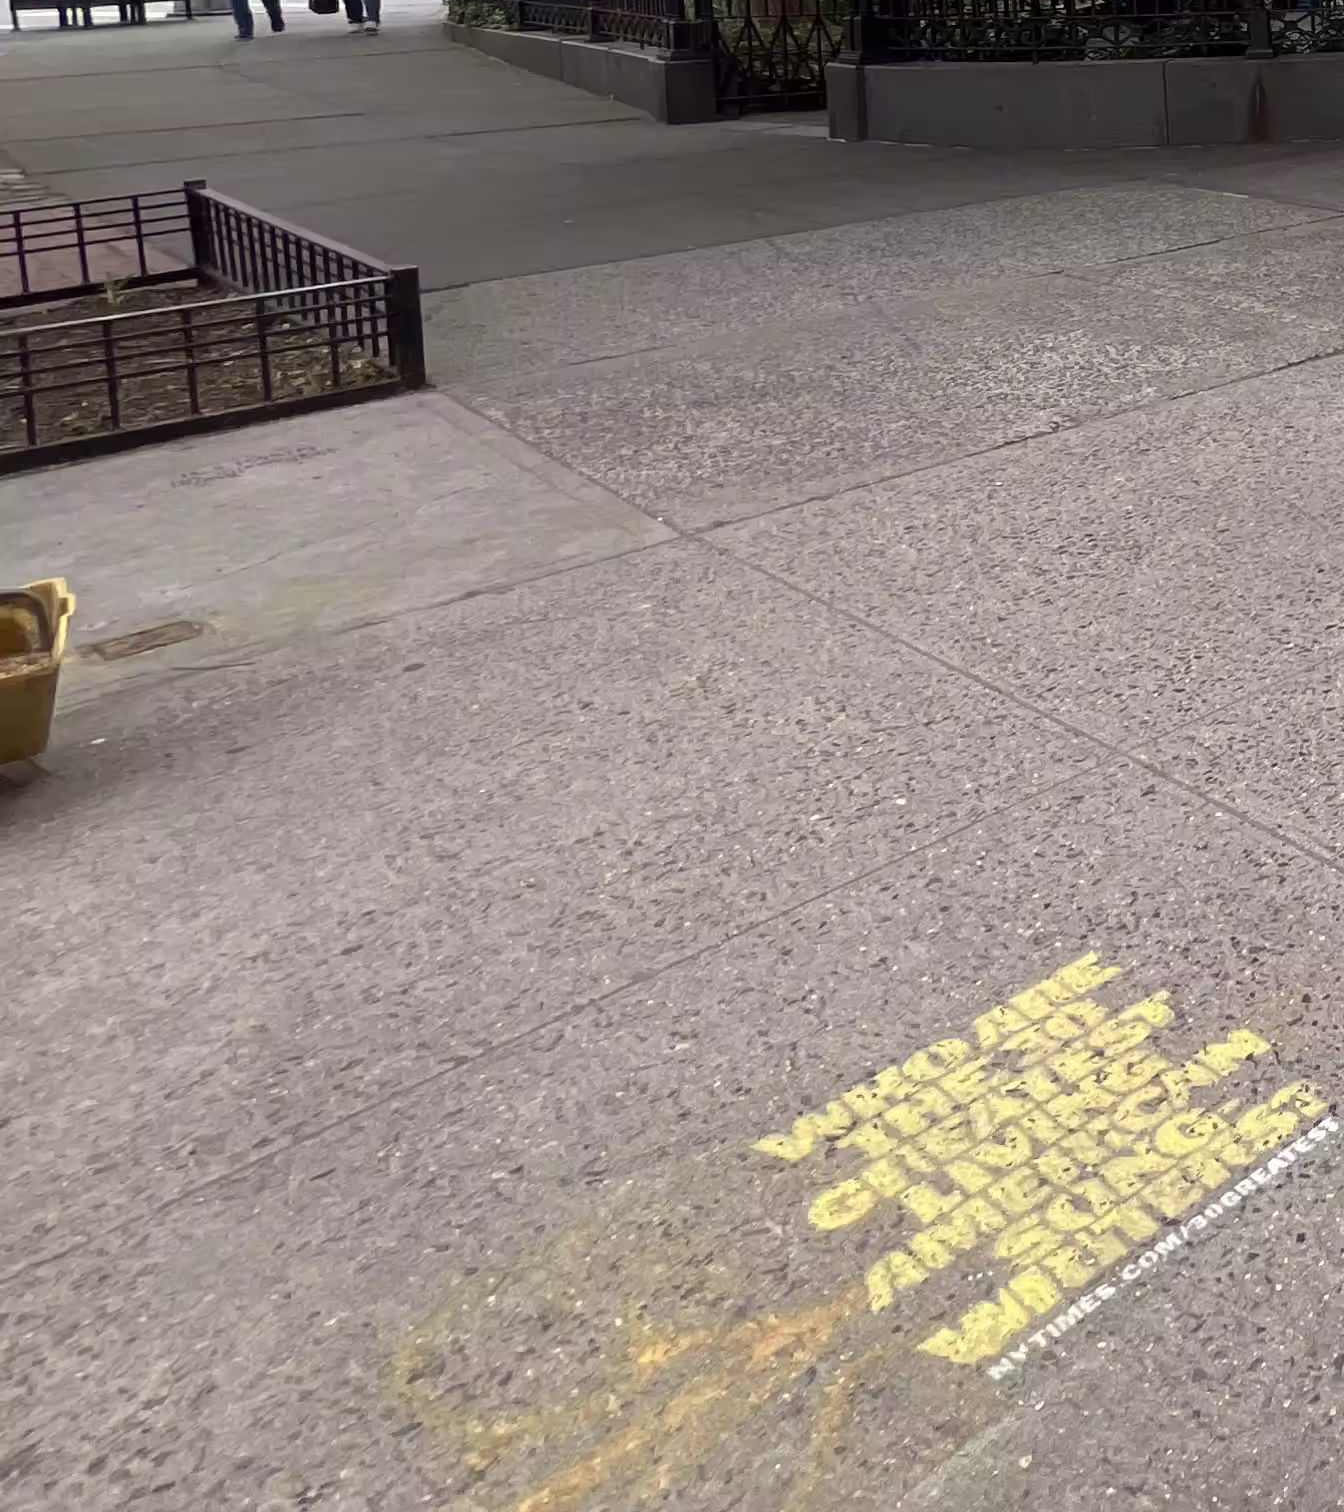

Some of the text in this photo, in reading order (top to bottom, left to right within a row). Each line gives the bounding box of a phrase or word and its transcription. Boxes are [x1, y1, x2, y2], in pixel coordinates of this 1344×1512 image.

[753, 951, 1121, 1159] WHO ARE
[838, 1052, 1009, 1158] THE
[893, 1050, 1171, 1223] LIVING
[865, 1027, 1271, 1312] AMERICAN
[988, 1116, 1339, 1380] NYTIMES.COM/30GREATEST
